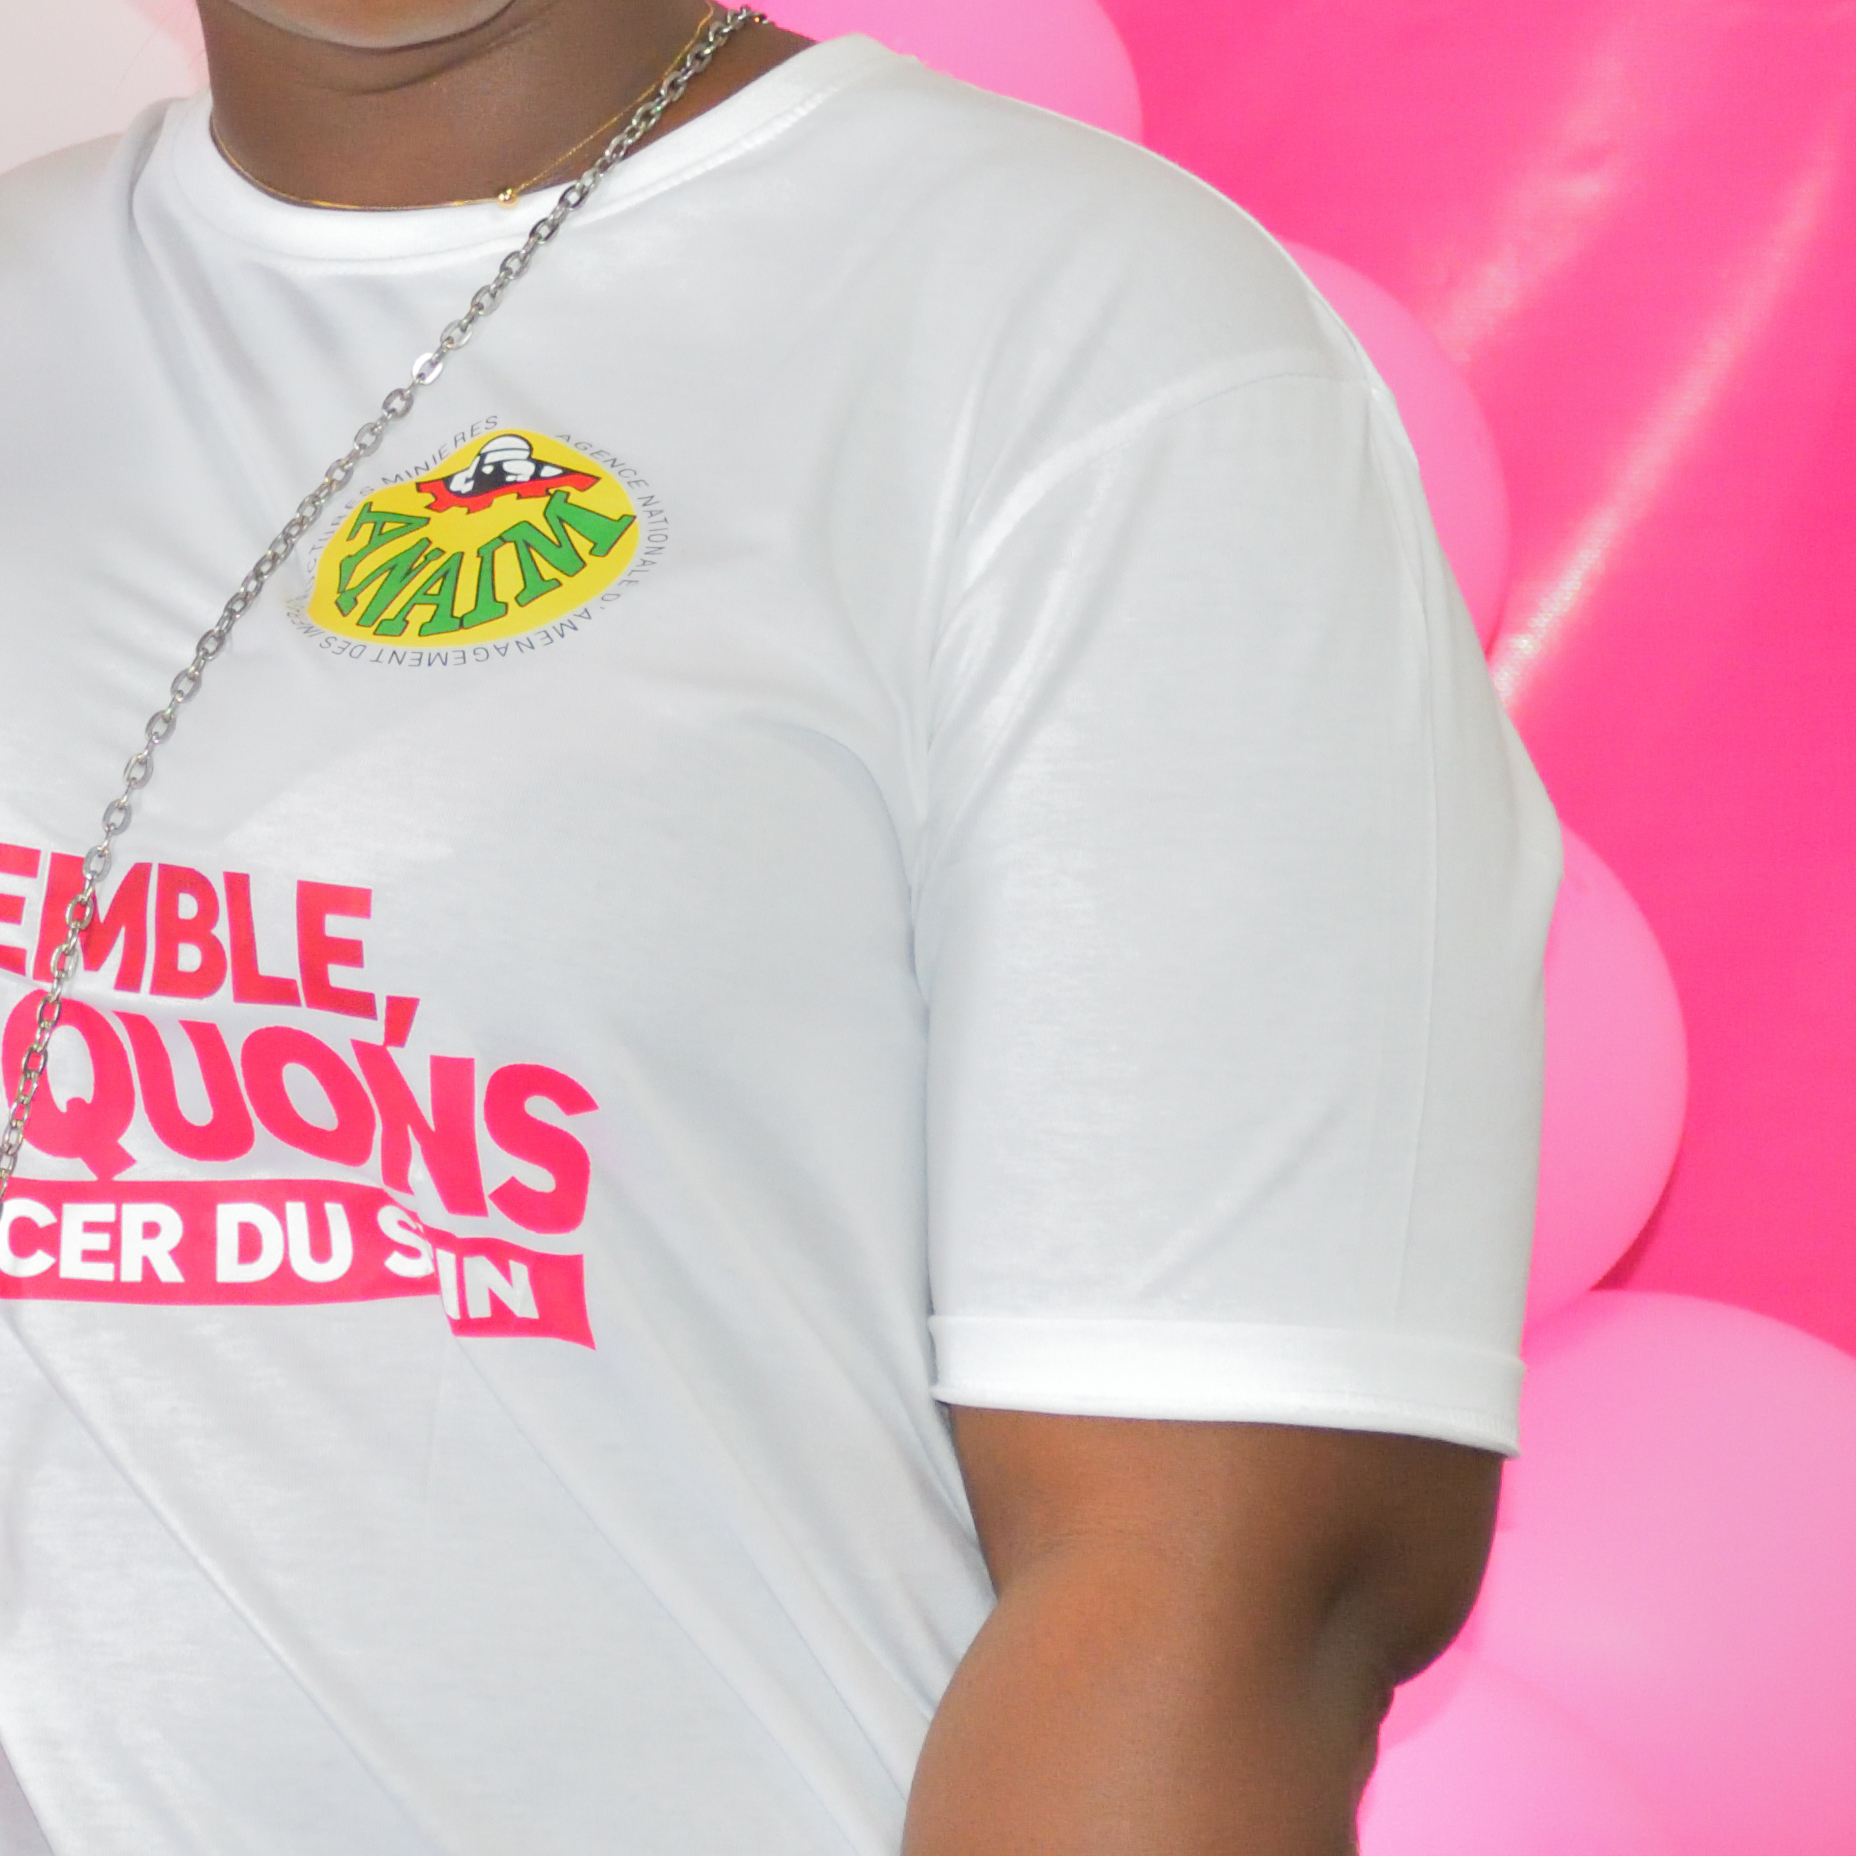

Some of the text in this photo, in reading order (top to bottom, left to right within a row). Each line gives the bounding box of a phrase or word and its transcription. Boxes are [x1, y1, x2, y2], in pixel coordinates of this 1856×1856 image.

[381, 415, 498, 484] MINIERES
[555, 434, 649, 489] AGENCE
[335, 490, 636, 636] ANAIM
[618, 495, 669, 587] NATIONALE
[319, 636, 366, 659] DES
[370, 593, 621, 666] D'AMENAGEMENT
[216, 1202, 354, 1284] DU
[377, 1205, 540, 1320] SIN
